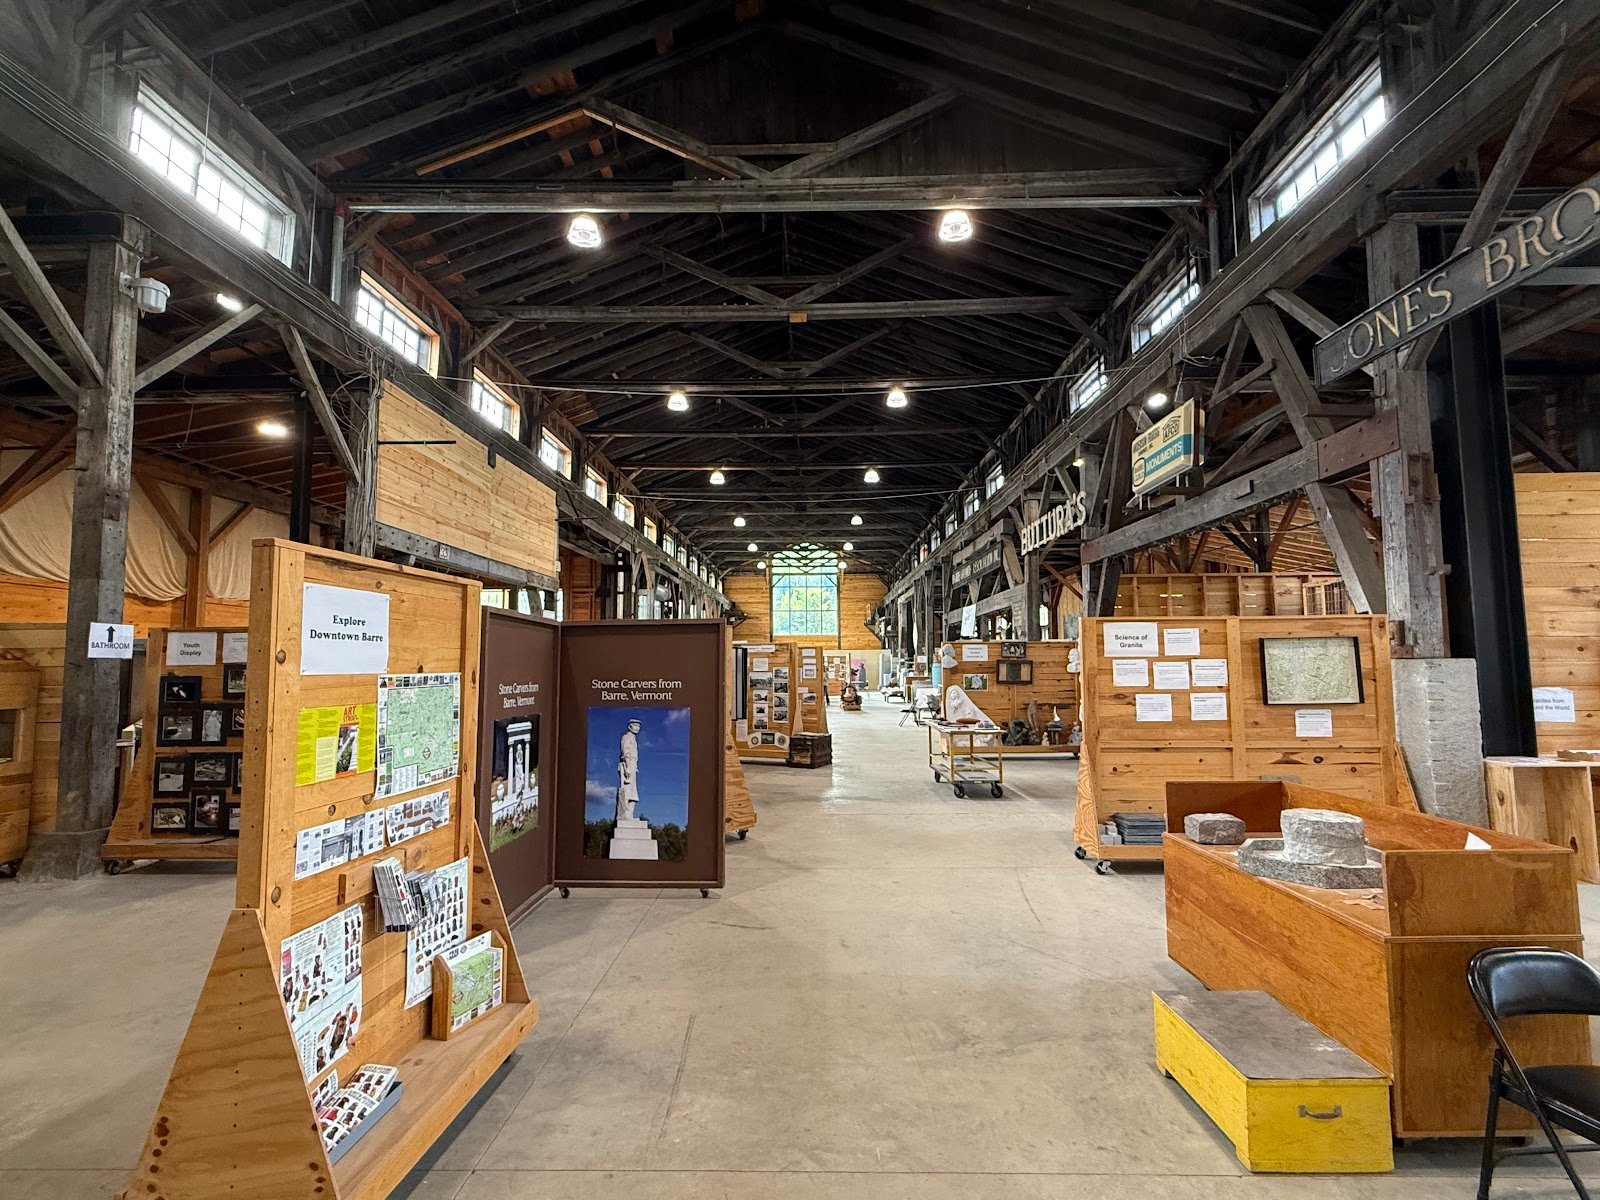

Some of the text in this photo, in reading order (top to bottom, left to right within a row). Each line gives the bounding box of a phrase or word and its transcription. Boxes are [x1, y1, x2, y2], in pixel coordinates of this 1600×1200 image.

[1331, 186, 1600, 374] JONES BRO
[1146, 441, 1183, 471] MONUMENTS
[332, 614, 367, 627] Explore
[309, 629, 384, 642] Downtown Barre
[91, 641, 130, 650] BATHROOM
[498, 681, 539, 695] Stone Carvers from
[591, 678, 682, 689] Stone Carvers from
[516, 695, 535, 706] Vermont
[630, 691, 673, 701] Vermont
[343, 705, 357, 717] ART
